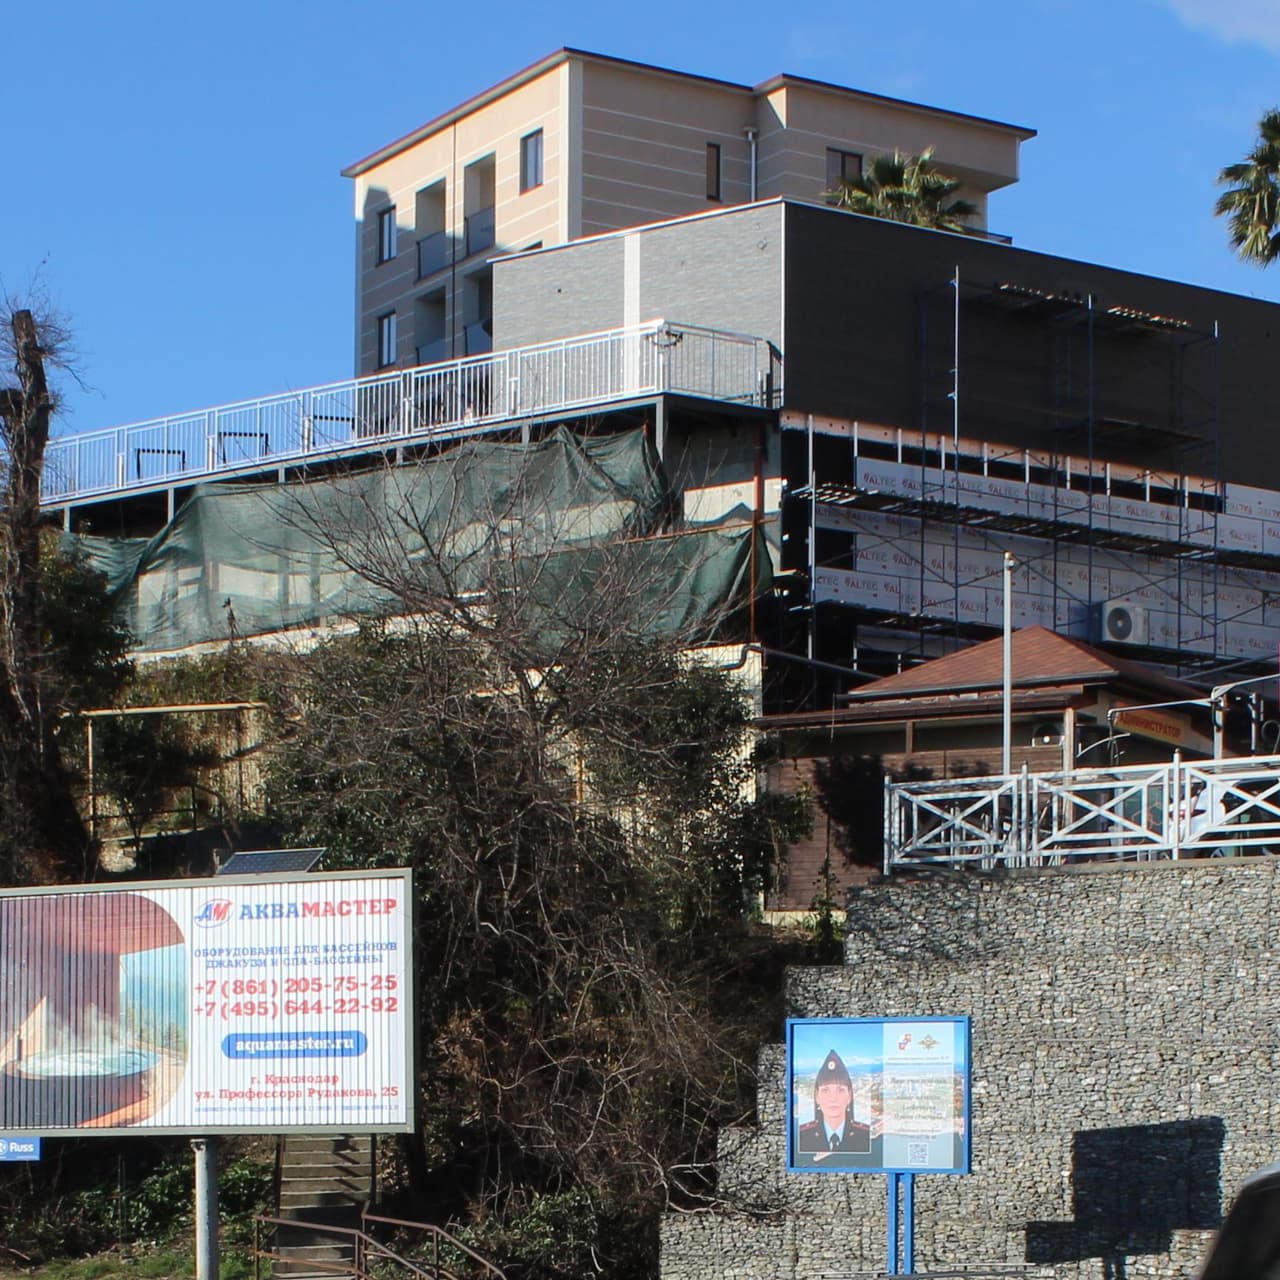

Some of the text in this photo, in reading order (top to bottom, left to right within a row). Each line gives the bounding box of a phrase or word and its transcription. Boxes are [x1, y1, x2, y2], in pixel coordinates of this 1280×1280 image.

[884, 582, 900, 594] VAL
[239, 898, 397, 920] АКВАМАСТЕР
[194, 941, 397, 958] ОБОРУДОВАНИЕ ДЛЯ БАССЕЙНОВ
[205, 958, 267, 969] ДЖАКУЗИ
[283, 953, 383, 967] СПА-БАССЕЙНЫ
[194, 974, 398, 998] +7 (861) 205-75-25
[194, 997, 398, 1021] +7 (495) 644-22-92
[235, 1036, 354, 1054] aquamaster.ru
[265, 1073, 339, 1086] Краснодар
[219, 1088, 303, 1101] Профессора
[307, 1087, 377, 1101] Рудакова,
[9, 1142, 34, 1152] Russ
